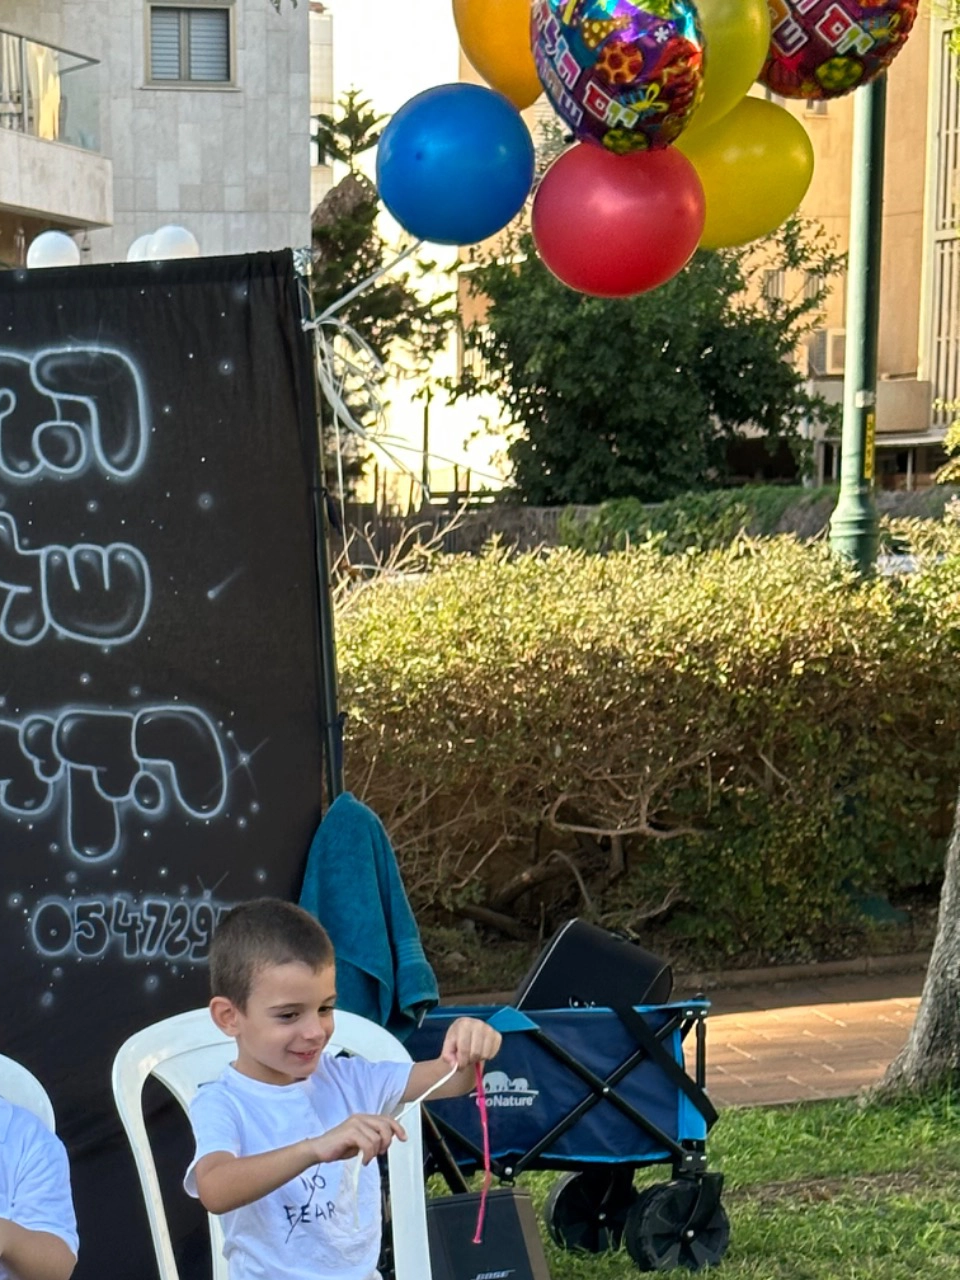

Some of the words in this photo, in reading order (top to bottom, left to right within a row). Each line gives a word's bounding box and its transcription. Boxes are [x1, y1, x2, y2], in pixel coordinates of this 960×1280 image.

[815, 3, 875, 55] יום
[582, 80, 639, 128] יום
[31, 898, 232, 961] 054729
[283, 1200, 337, 1226] FEAR
